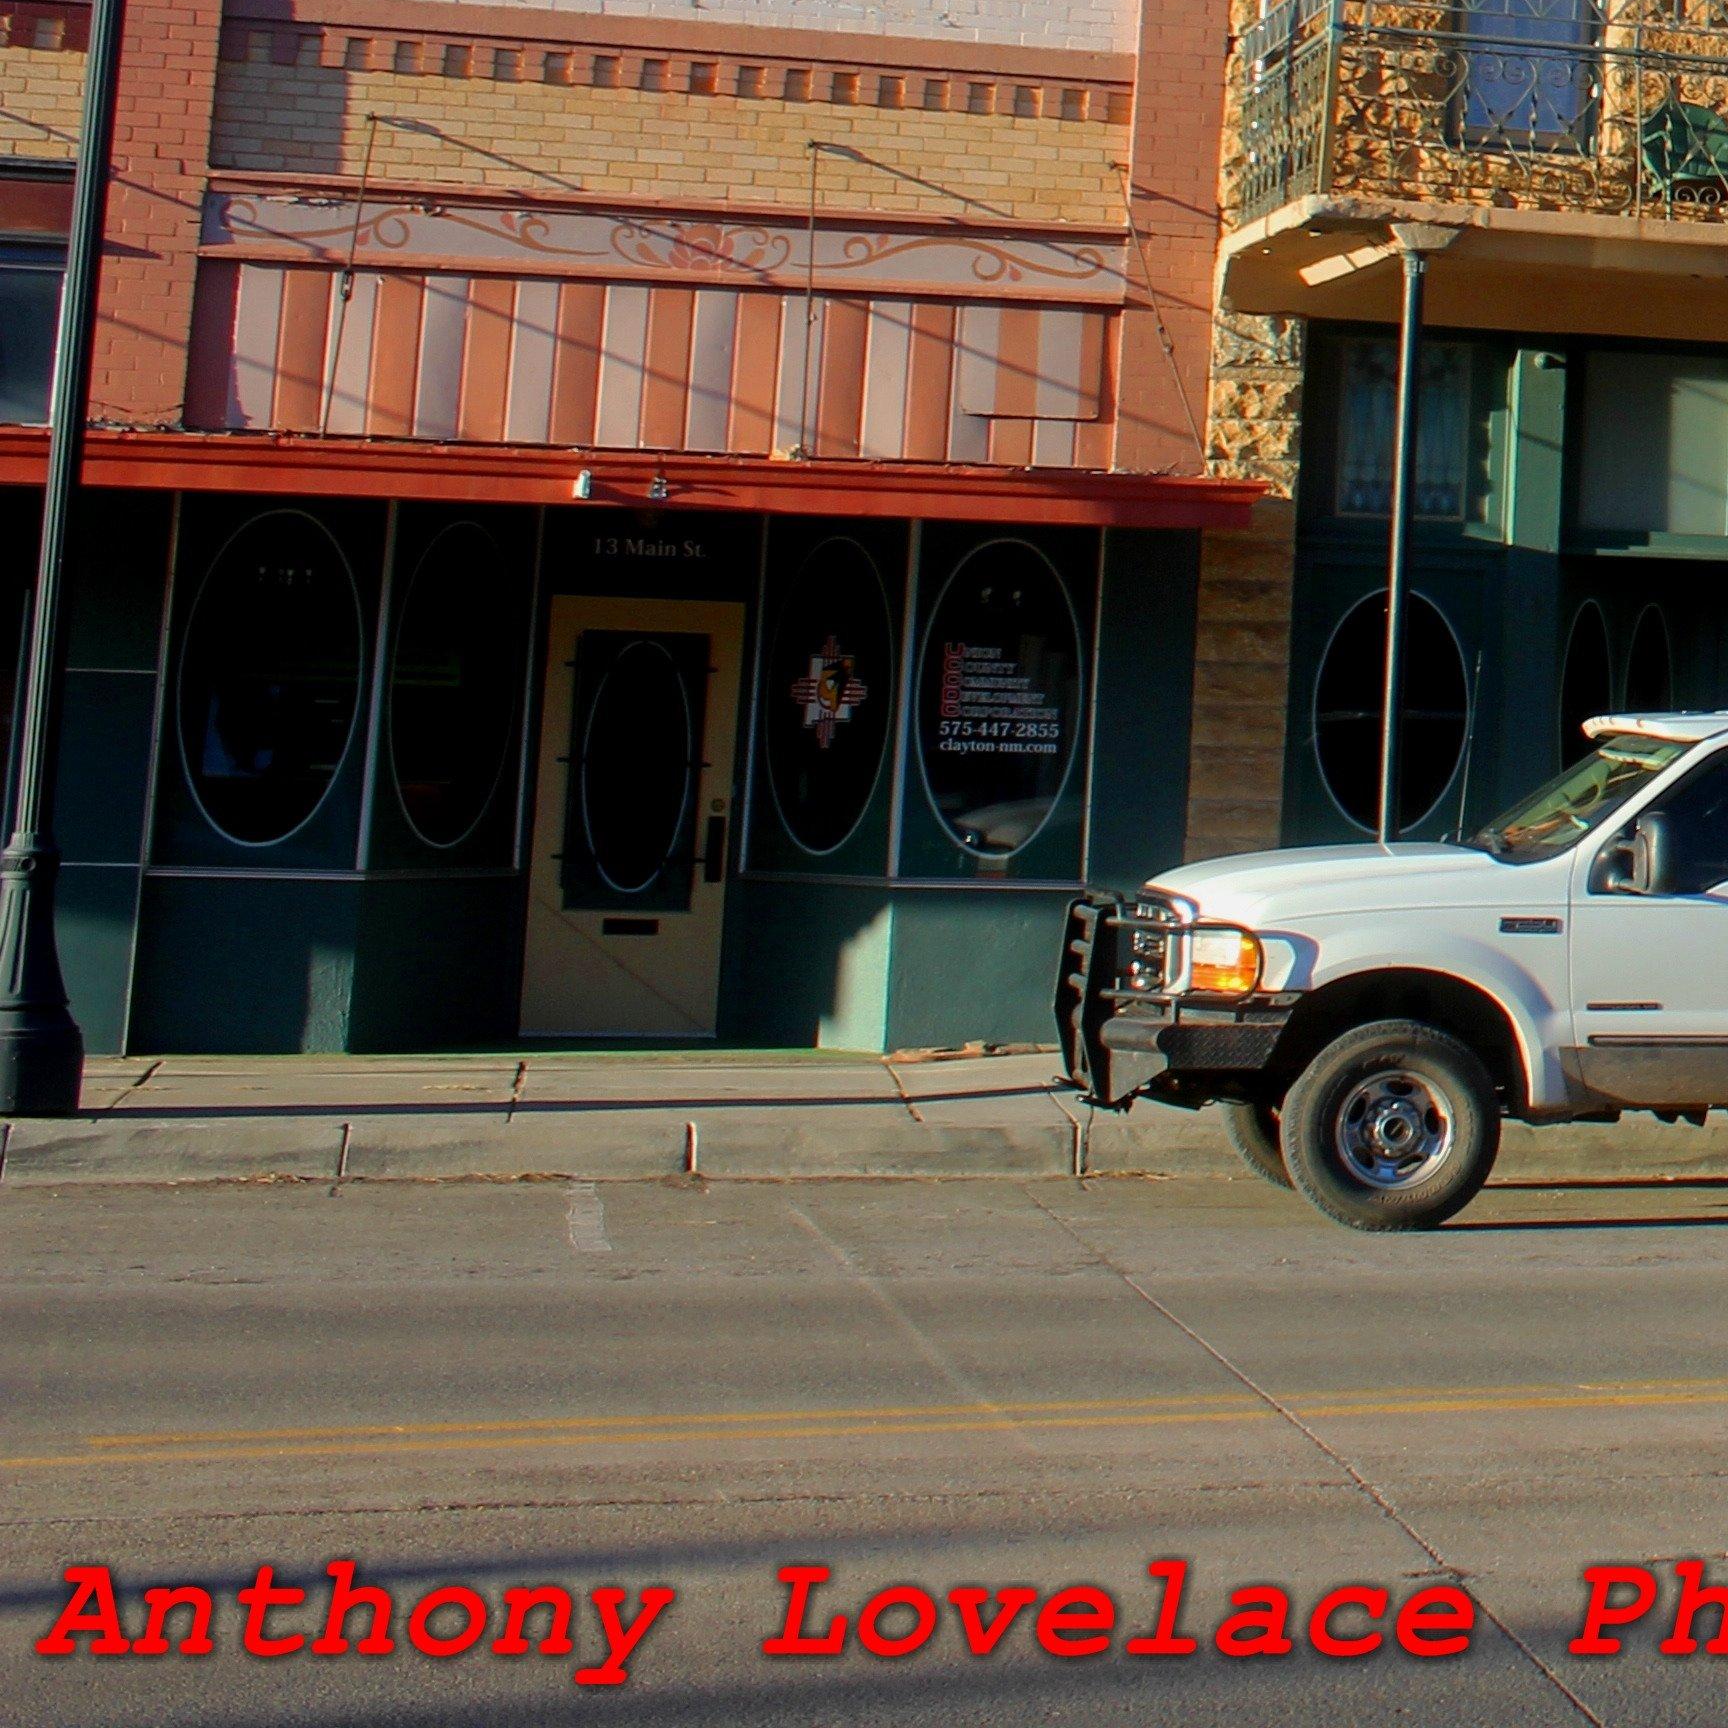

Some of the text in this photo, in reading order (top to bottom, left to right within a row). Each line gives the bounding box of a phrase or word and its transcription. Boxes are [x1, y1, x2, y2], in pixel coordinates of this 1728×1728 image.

[593, 537, 619, 556] 13
[625, 537, 677, 558] Main
[938, 720, 1061, 739] 575-447-2855
[938, 738, 1058, 756] clayton-nm.com
